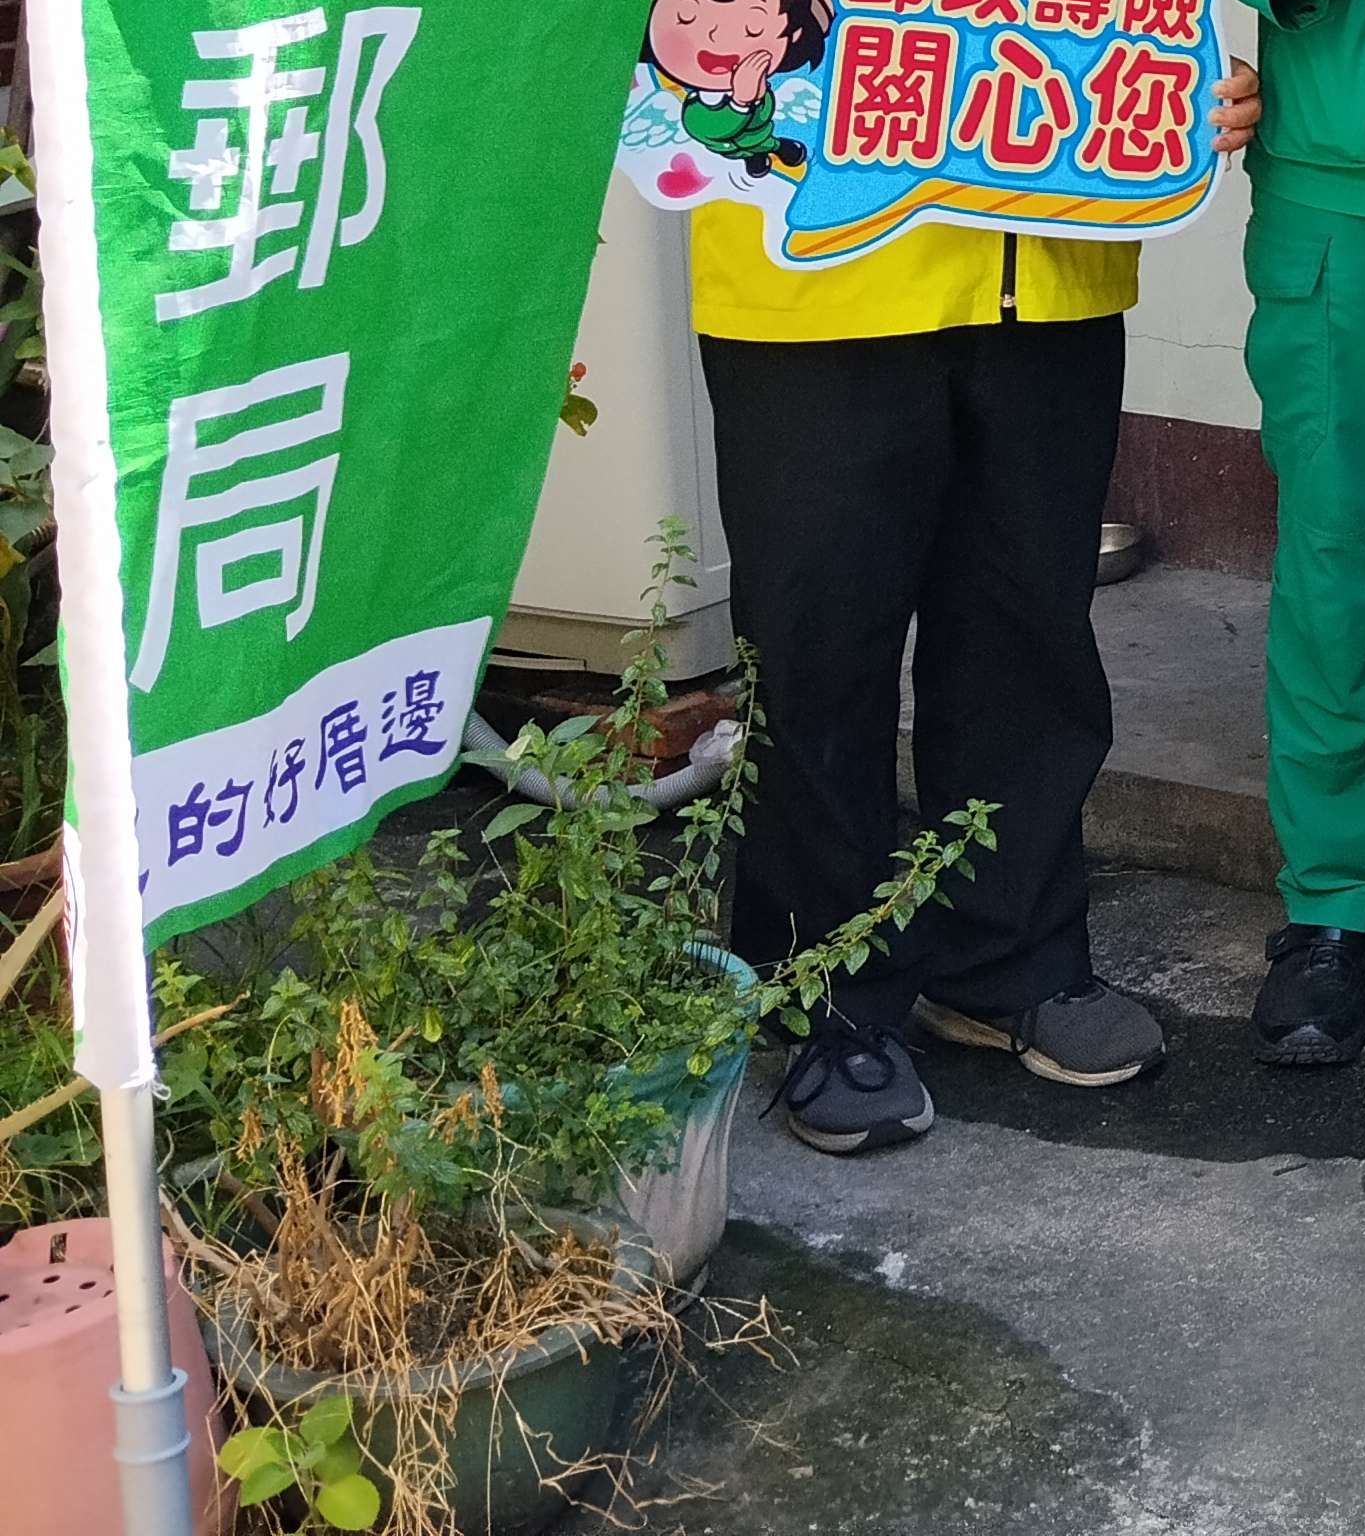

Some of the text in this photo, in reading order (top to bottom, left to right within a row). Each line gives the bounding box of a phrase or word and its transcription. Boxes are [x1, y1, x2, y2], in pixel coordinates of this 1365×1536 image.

[832, 24, 1193, 173] 關心您
[137, 671, 447, 896] 的好厝邊
